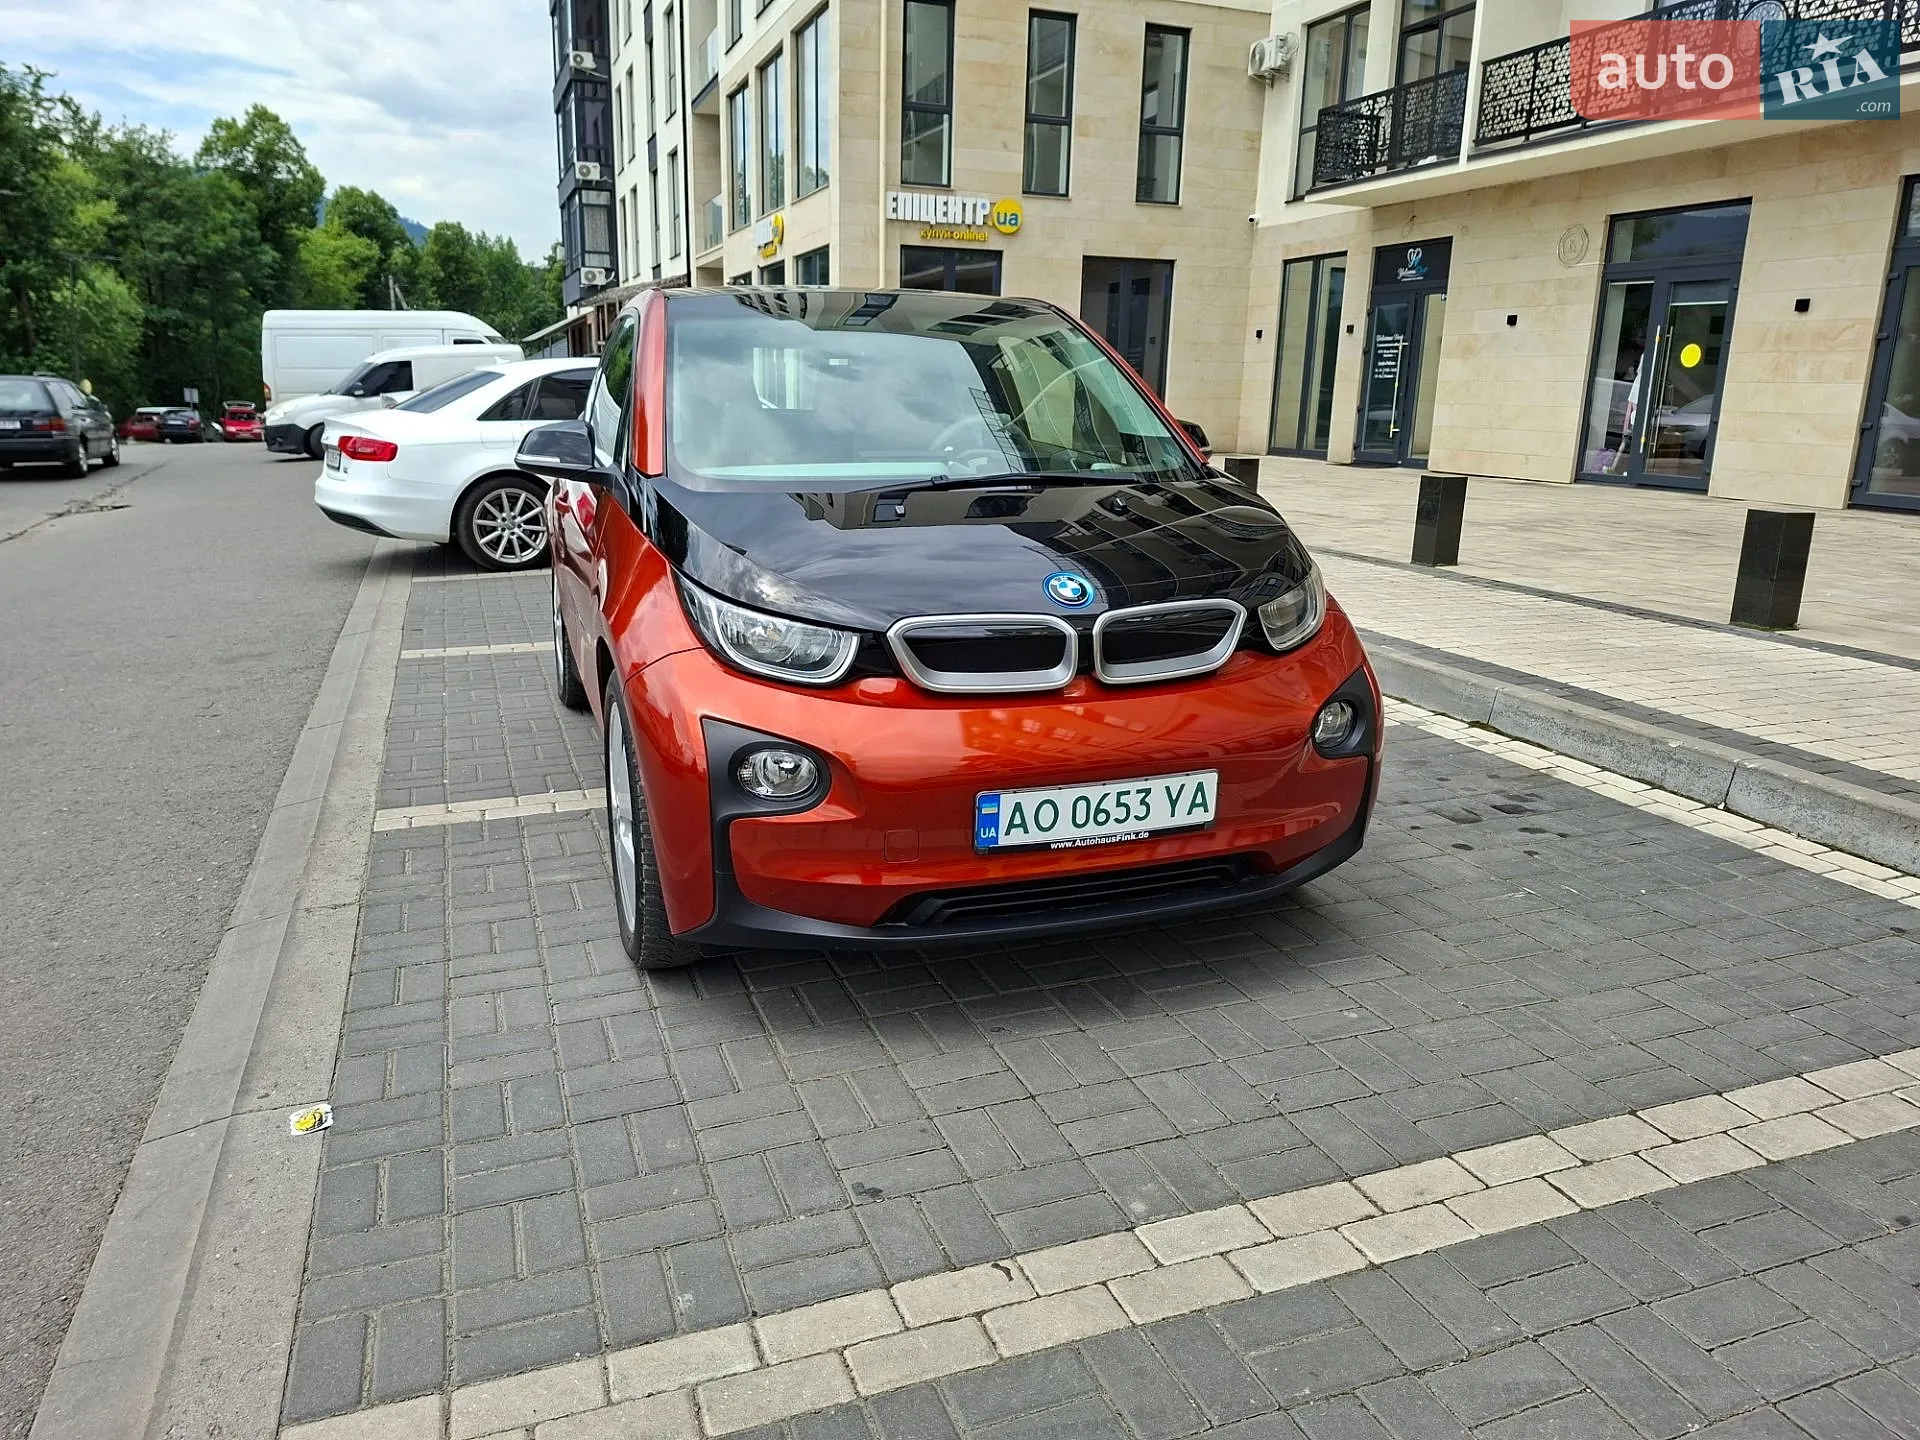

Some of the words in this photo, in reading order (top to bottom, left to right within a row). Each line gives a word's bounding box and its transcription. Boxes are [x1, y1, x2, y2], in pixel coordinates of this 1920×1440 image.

[886, 190, 991, 226] ЕПІЦЕНТР
[952, 229, 989, 242] online!
[1004, 798, 1060, 837] AO
[1071, 787, 1153, 830] 0653
[1164, 781, 1210, 818] YA
[980, 828, 998, 840] UA
[1050, 830, 1150, 850] www.AutohausFink.de
